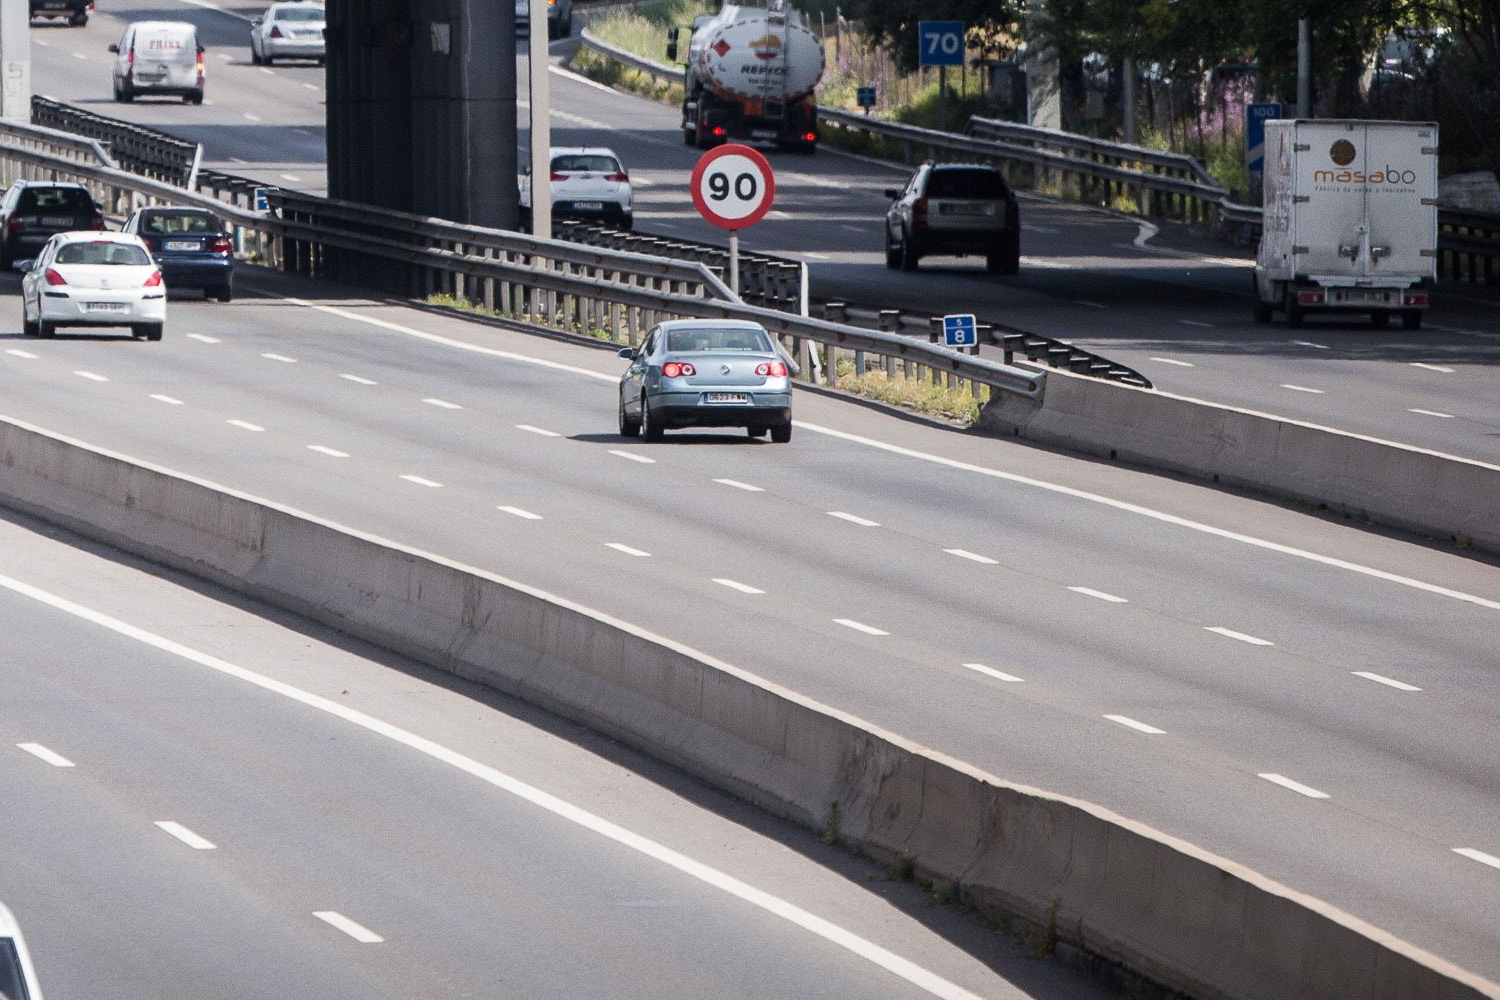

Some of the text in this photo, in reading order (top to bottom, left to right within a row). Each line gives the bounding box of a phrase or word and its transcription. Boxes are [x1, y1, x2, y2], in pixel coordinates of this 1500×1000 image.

[924, 32, 959, 55] 70
[1253, 106, 1275, 118] 100
[1314, 164, 1416, 184] masabo
[709, 172, 757, 201] 90
[956, 318, 963, 326] 5
[954, 329, 965, 343] 8
